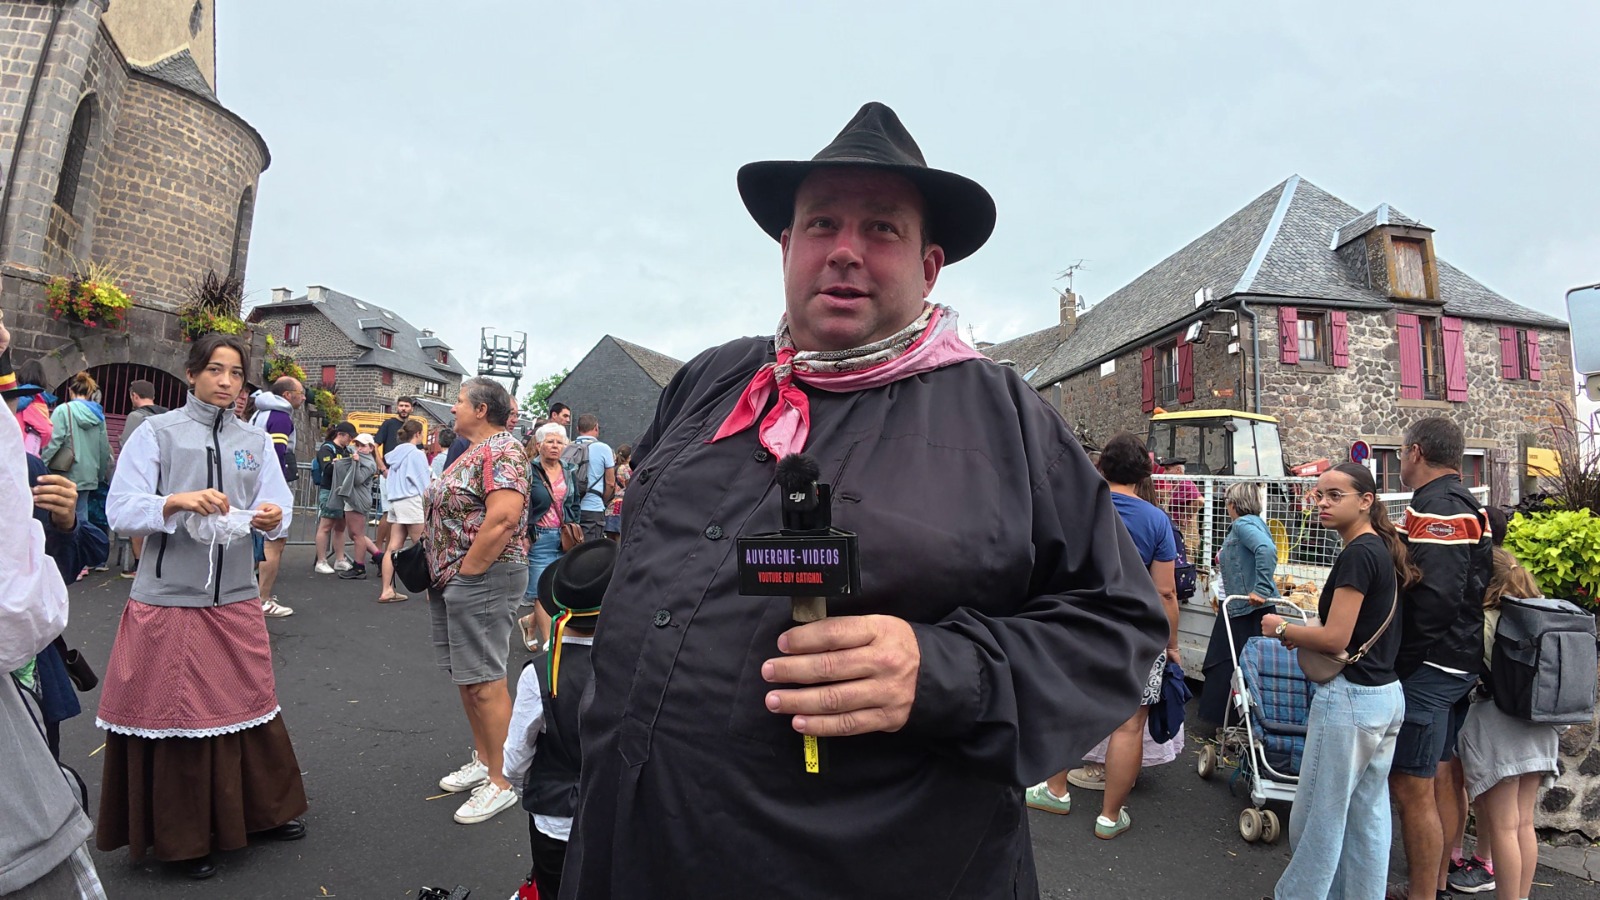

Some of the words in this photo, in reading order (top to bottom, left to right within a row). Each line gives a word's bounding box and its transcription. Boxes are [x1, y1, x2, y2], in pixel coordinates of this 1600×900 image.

[746, 548, 839, 565] AUVERGNE-VIDEOS
[758, 571, 782, 583] YOUTUBE
[783, 571, 795, 583] GUY
[795, 571, 824, 584] GATIGNOL
